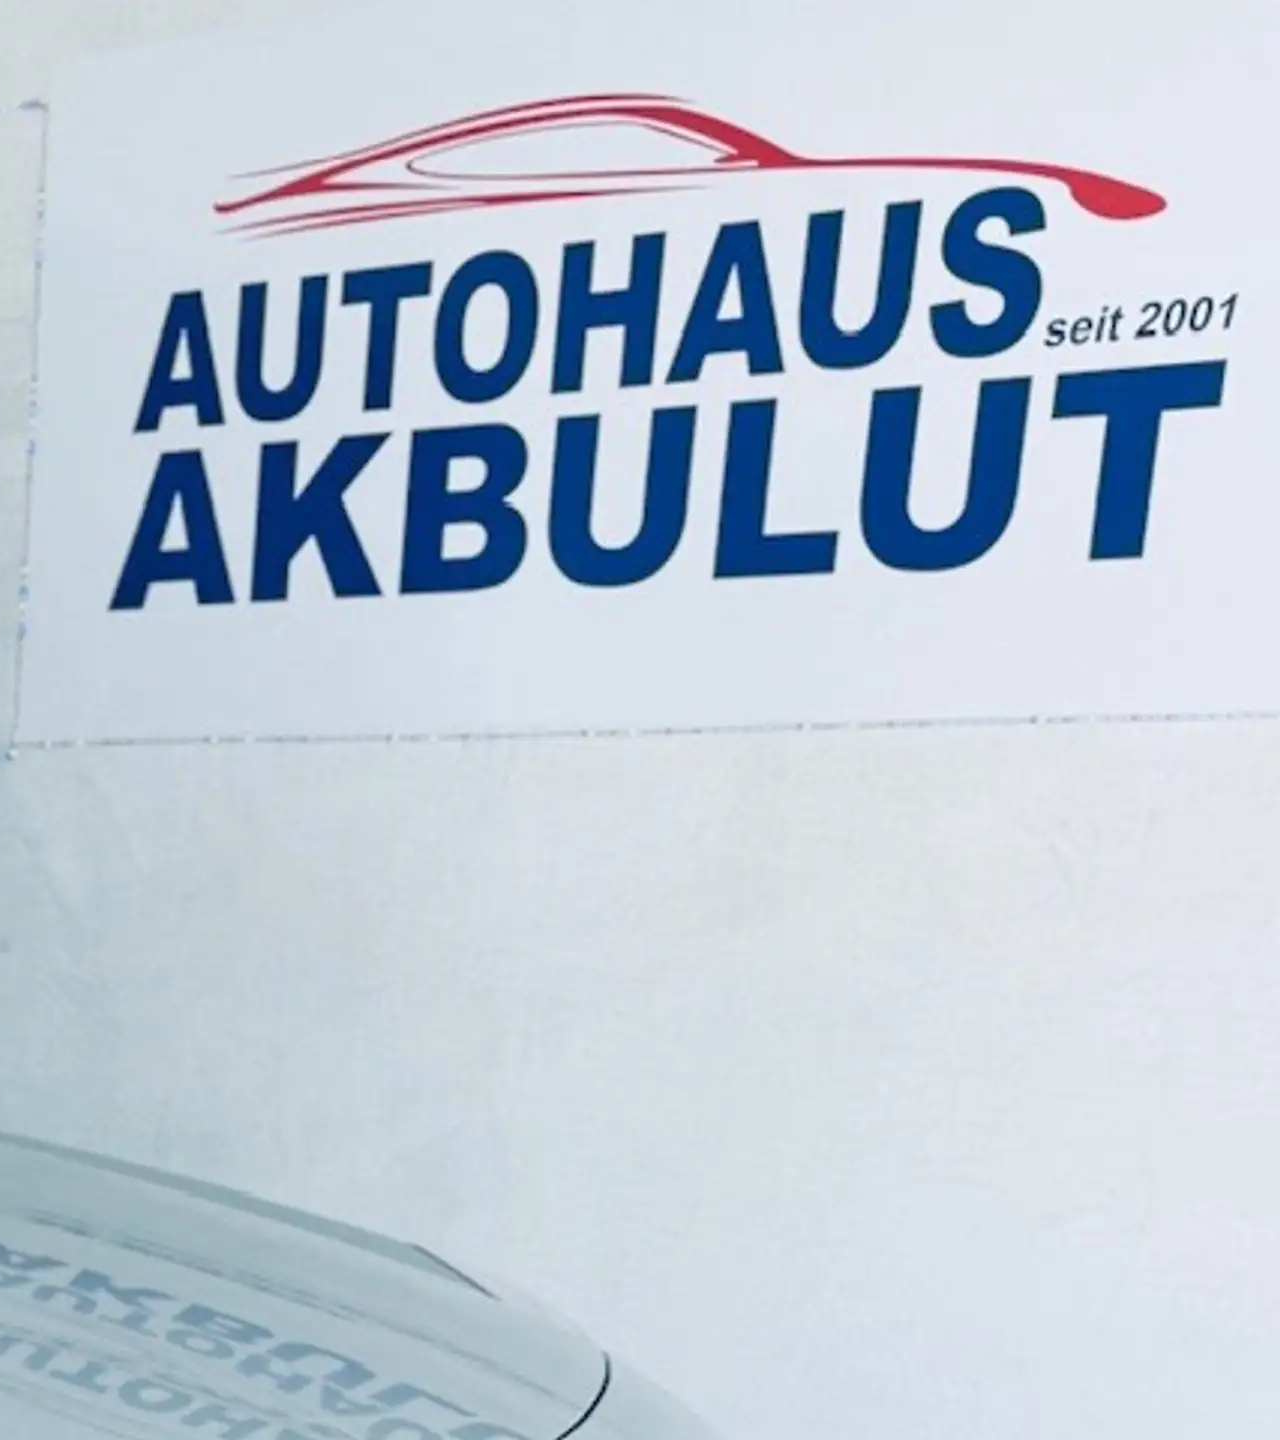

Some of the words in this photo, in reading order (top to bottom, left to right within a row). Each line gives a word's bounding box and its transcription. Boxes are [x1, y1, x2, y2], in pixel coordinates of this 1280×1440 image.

[133, 186, 1047, 434] AUTOHAUS
[1044, 305, 1124, 347] seit
[1134, 293, 1238, 340] 2001
[108, 359, 1227, 612] AKBULUT
